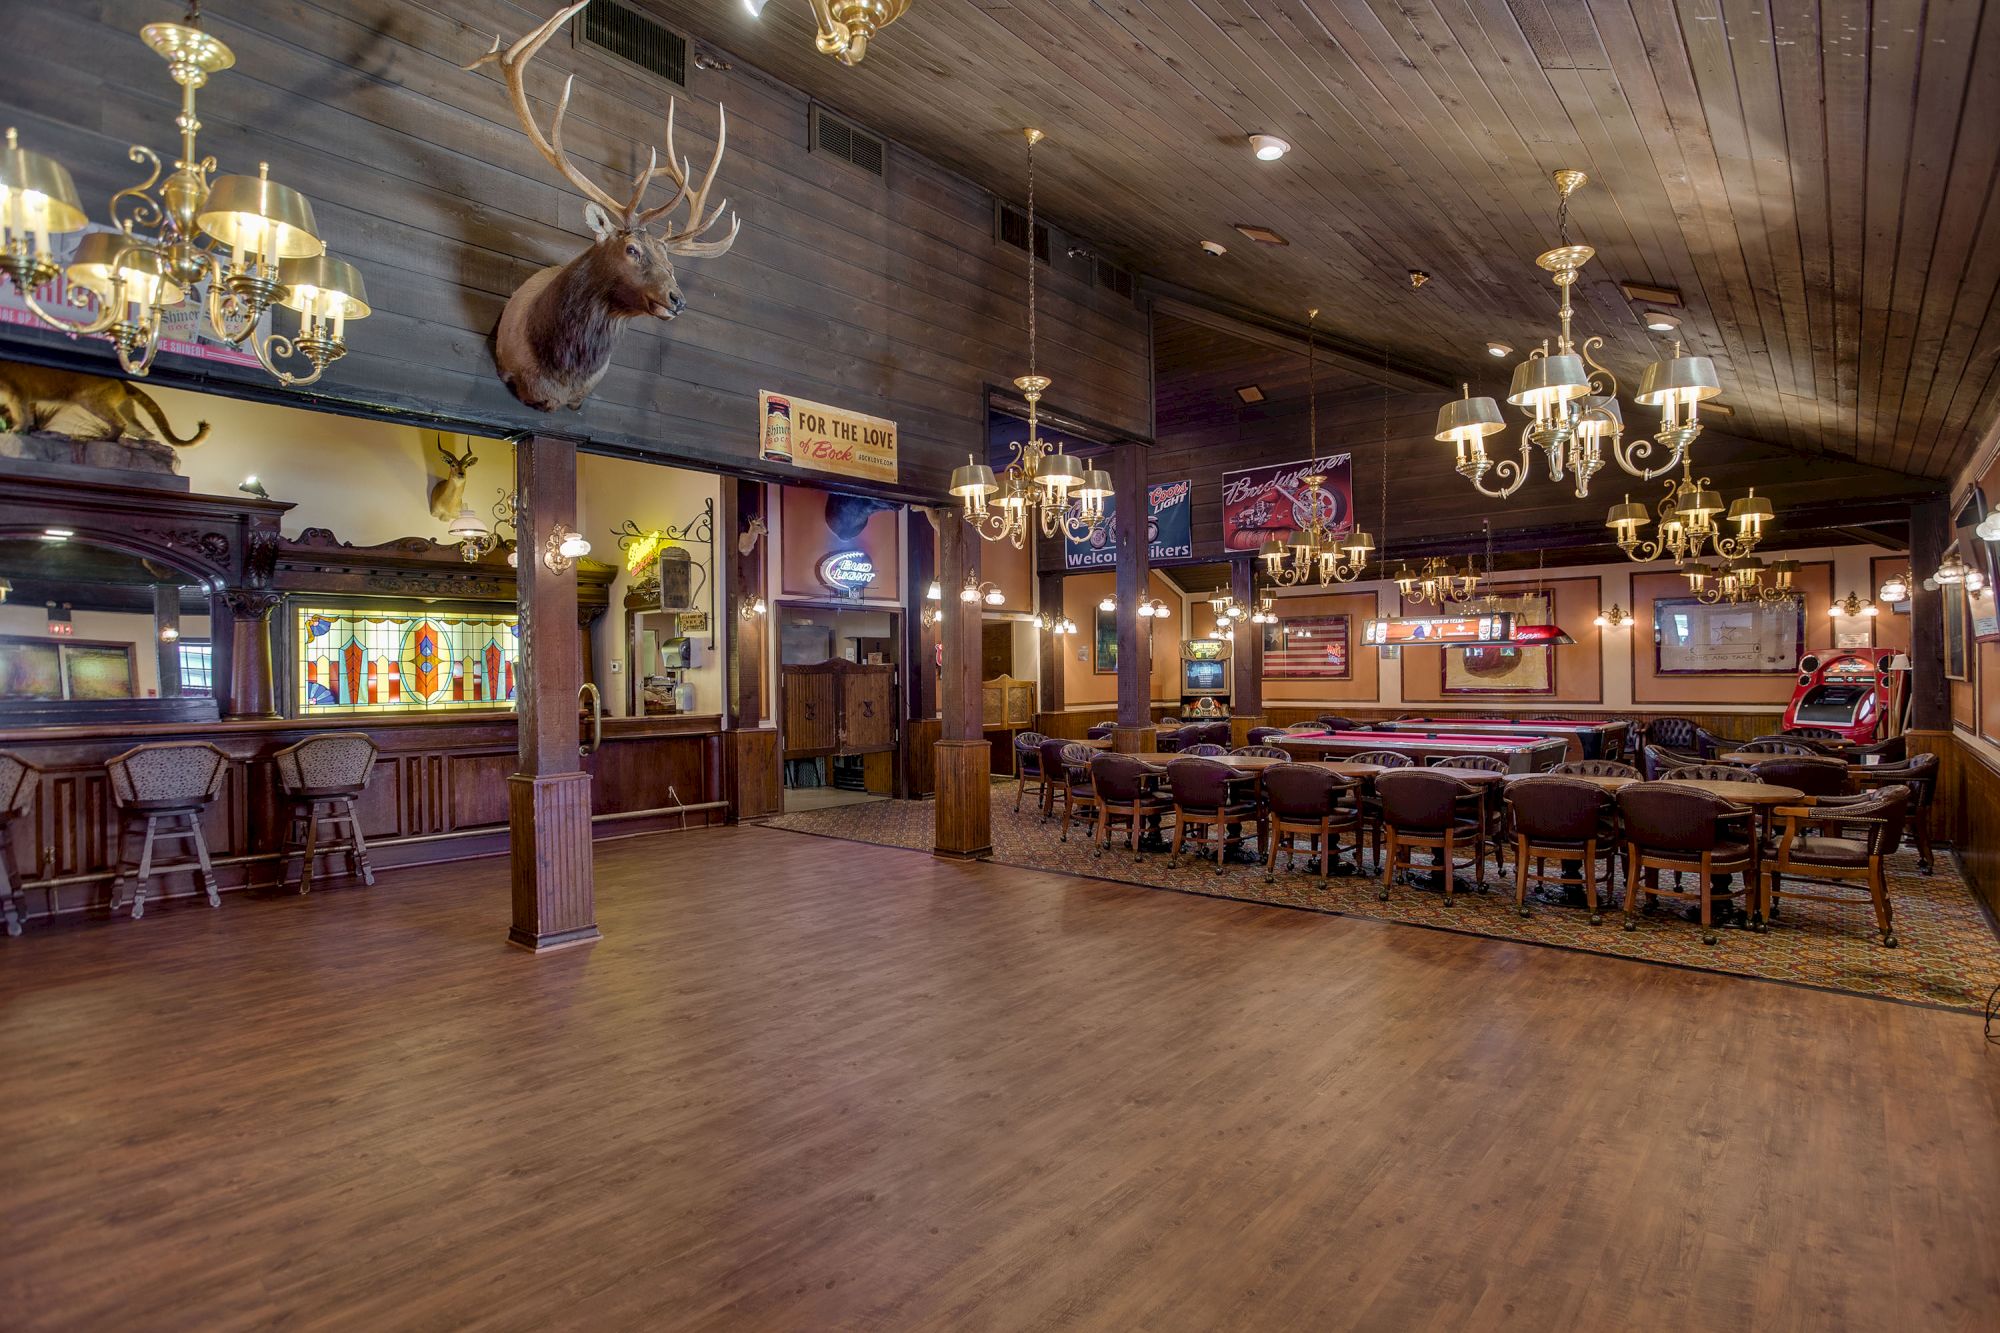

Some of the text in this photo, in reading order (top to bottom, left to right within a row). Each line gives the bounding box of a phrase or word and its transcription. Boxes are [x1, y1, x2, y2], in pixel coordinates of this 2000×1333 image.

[161, 310, 200, 324] Shiner
[799, 412, 893, 449] FOR THE LOVE
[799, 438, 812, 454] of
[1223, 454, 1351, 505] Budweiser
[1149, 481, 1189, 507] Coors
[1153, 493, 1187, 514] LIGHT
[1068, 545, 1189, 567] Welco ikers
